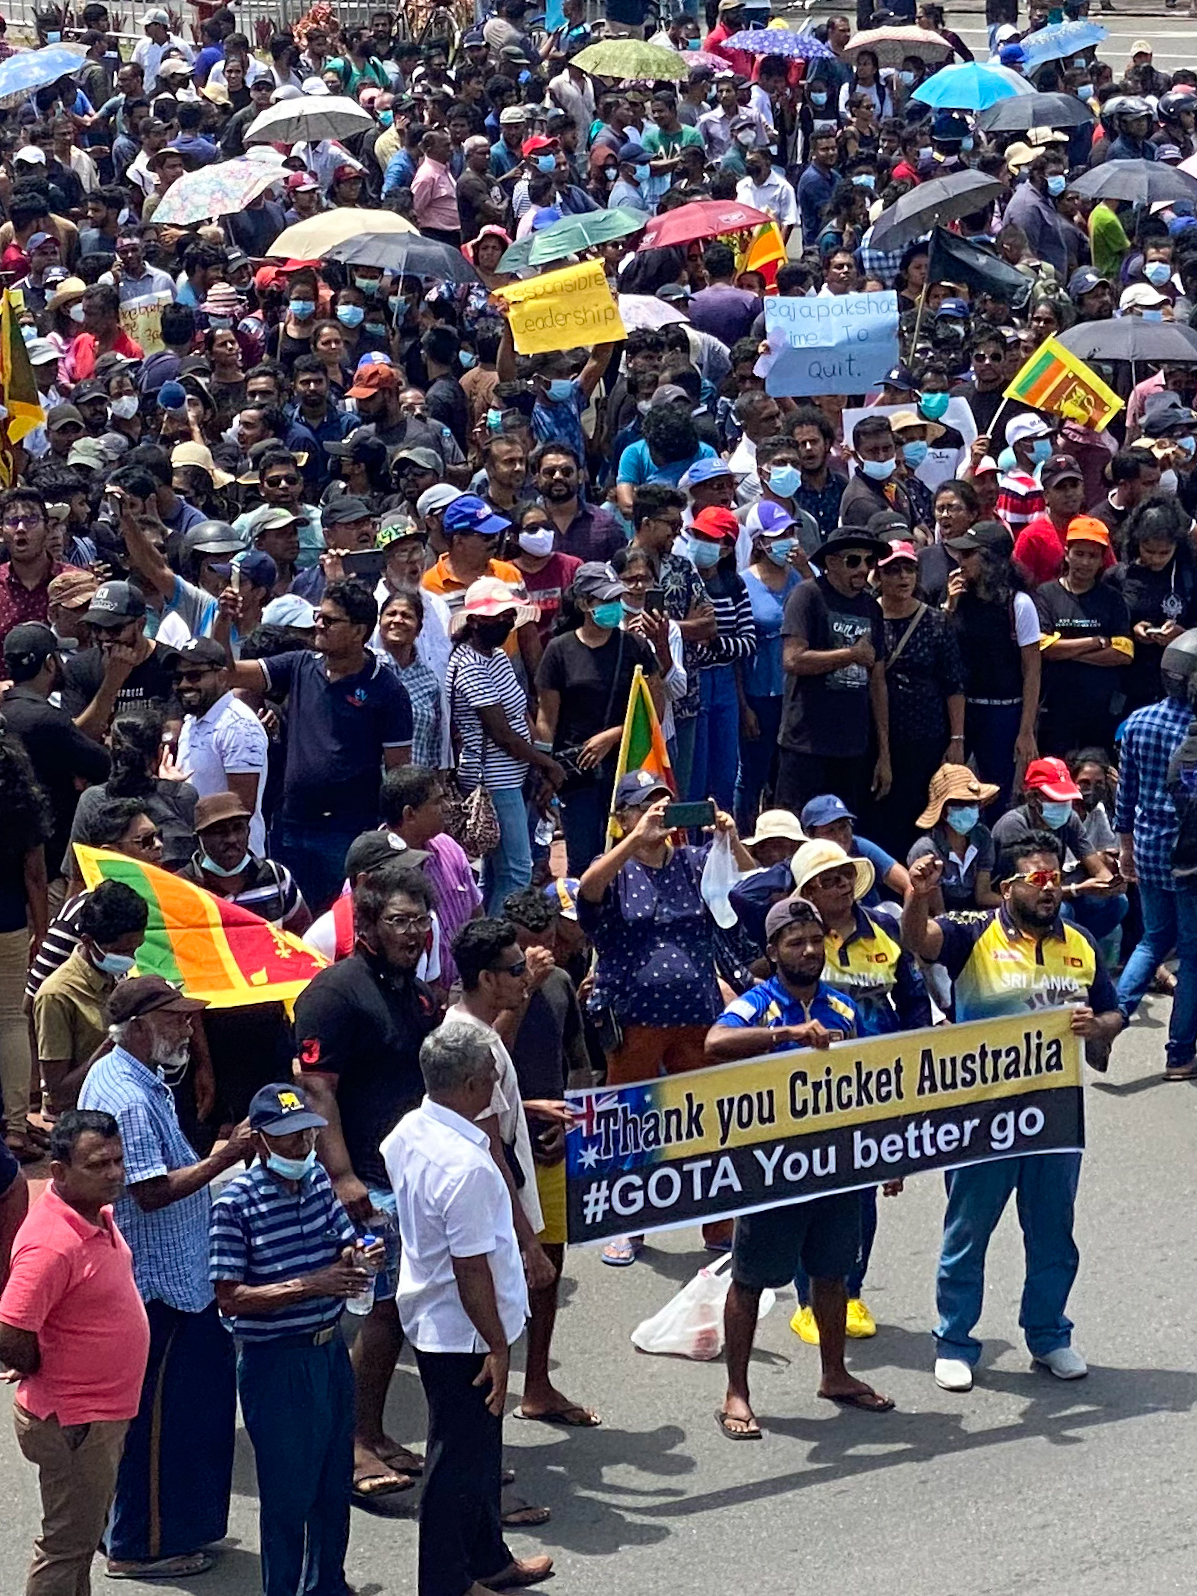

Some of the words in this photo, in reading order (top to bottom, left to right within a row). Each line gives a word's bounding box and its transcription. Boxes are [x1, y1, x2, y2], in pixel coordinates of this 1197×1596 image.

[765, 294, 898, 322] Rajapakshas
[785, 330, 819, 347] ime
[841, 324, 869, 343] To
[808, 353, 862, 380] Quit.
[1000, 972, 1027, 989] SRI
[1031, 974, 1080, 992] LANKA
[596, 1091, 705, 1161] Thank
[716, 1087, 776, 1147] you
[788, 1056, 905, 1120] Cricket
[916, 1029, 1064, 1097] Australia
[582, 1155, 743, 1225] #GOTA
[752, 1144, 837, 1187] You
[852, 1116, 981, 1171] better
[989, 1106, 1046, 1152] go
